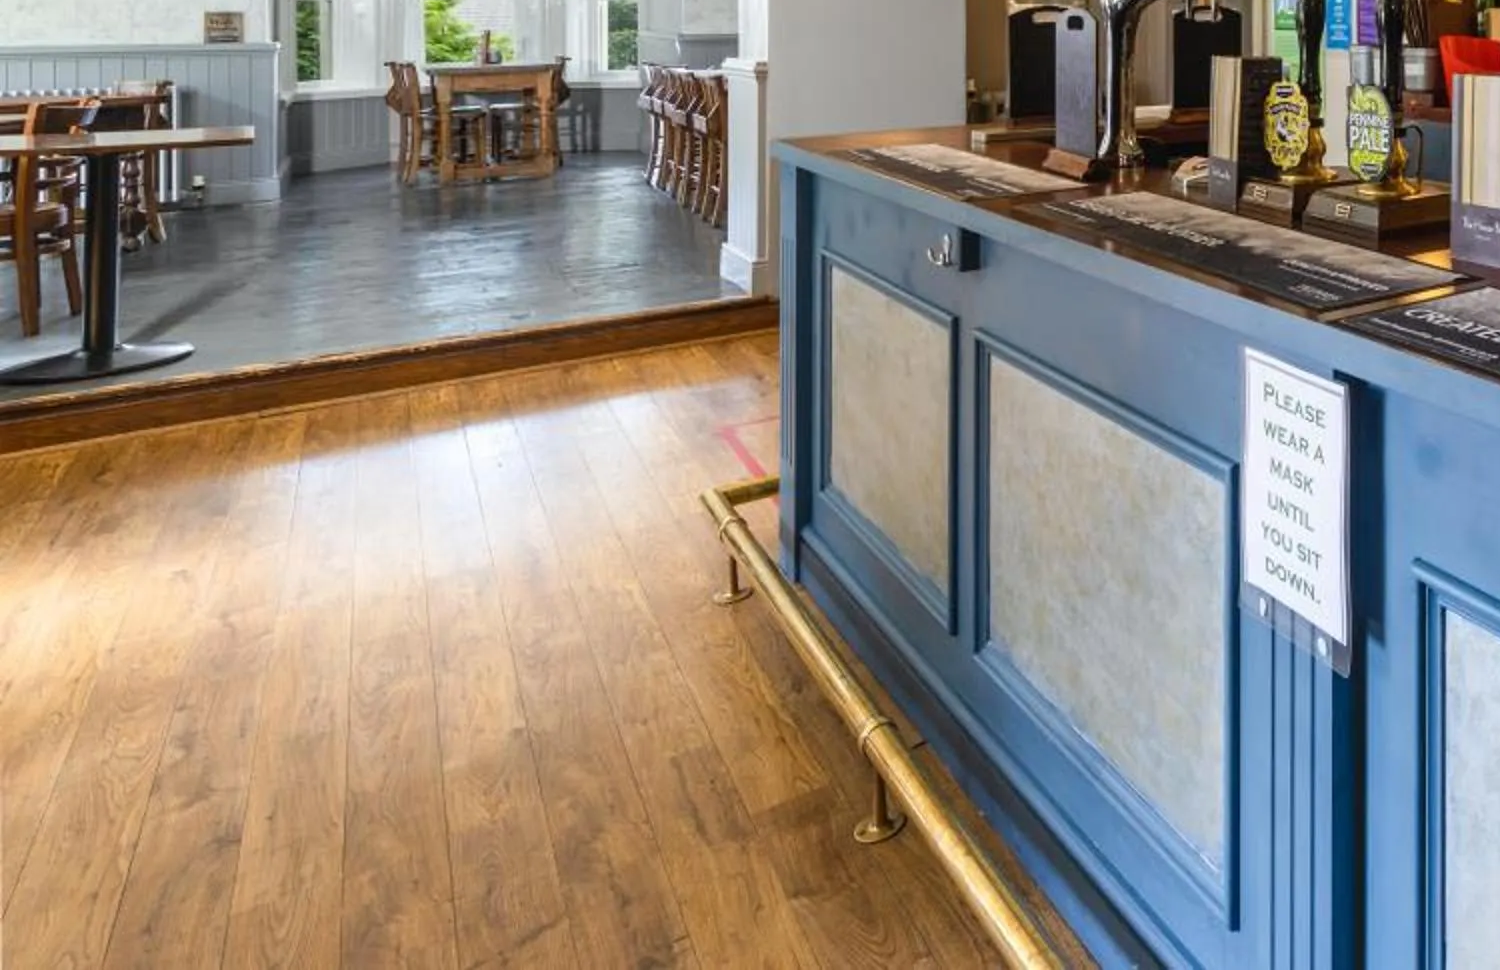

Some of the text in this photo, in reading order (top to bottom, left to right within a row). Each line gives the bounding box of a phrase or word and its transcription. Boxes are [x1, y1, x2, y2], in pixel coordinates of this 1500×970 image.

[1350, 126, 1389, 152] PALE
[1262, 383, 1327, 430] PLEASE
[1263, 419, 1325, 464] WEAR A
[1269, 458, 1314, 496] MASK
[1267, 491, 1315, 532] UNTIL
[1261, 521, 1323, 570] YOU SIT
[1265, 556, 1321, 604] DOWN.
